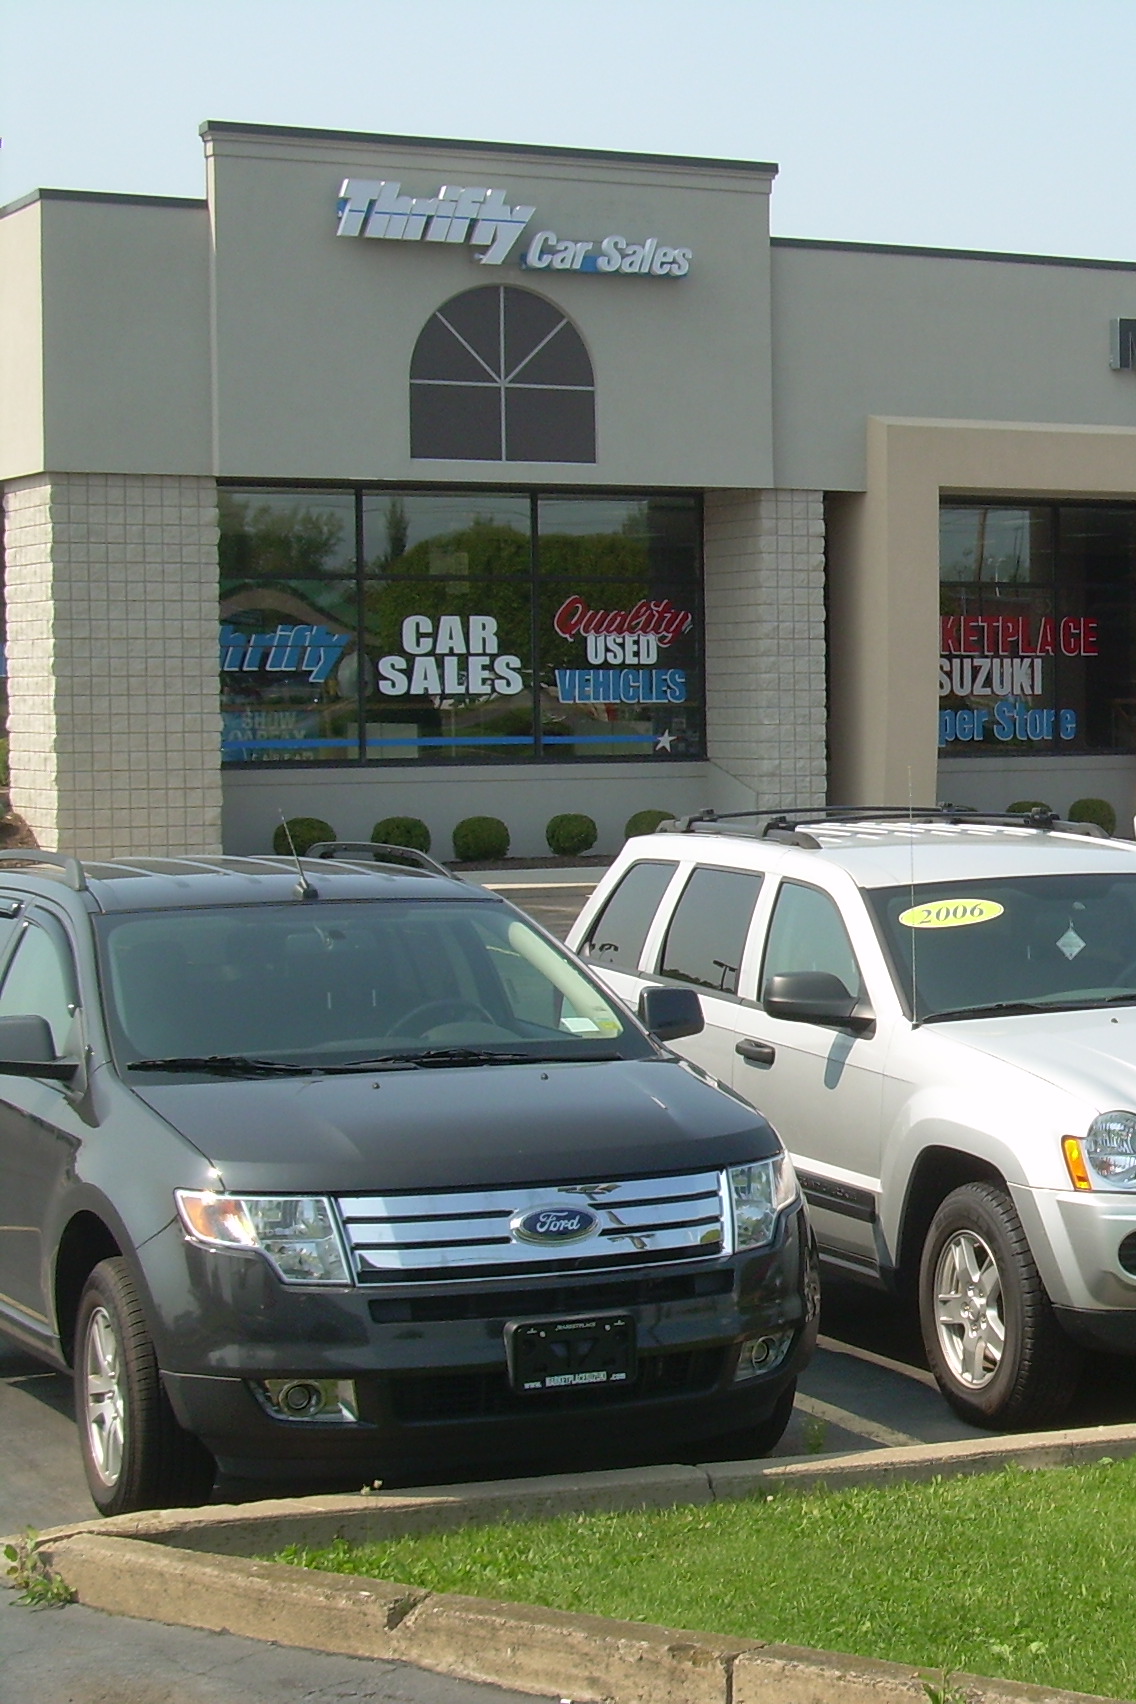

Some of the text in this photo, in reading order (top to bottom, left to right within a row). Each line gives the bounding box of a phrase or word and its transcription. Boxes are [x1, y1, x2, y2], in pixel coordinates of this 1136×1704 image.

[337, 178, 692, 277] Thrifty Car Sales
[402, 615, 498, 654] CAR
[554, 595, 694, 648] Quality
[586, 635, 658, 665] USED
[378, 656, 523, 696] SALES
[555, 669, 688, 704] VEHICLES
[939, 658, 1043, 696] SUZUKI
[938, 699, 1077, 747] per Store
[918, 902, 985, 925] 2006
[536, 1212, 580, 1232] Ford
